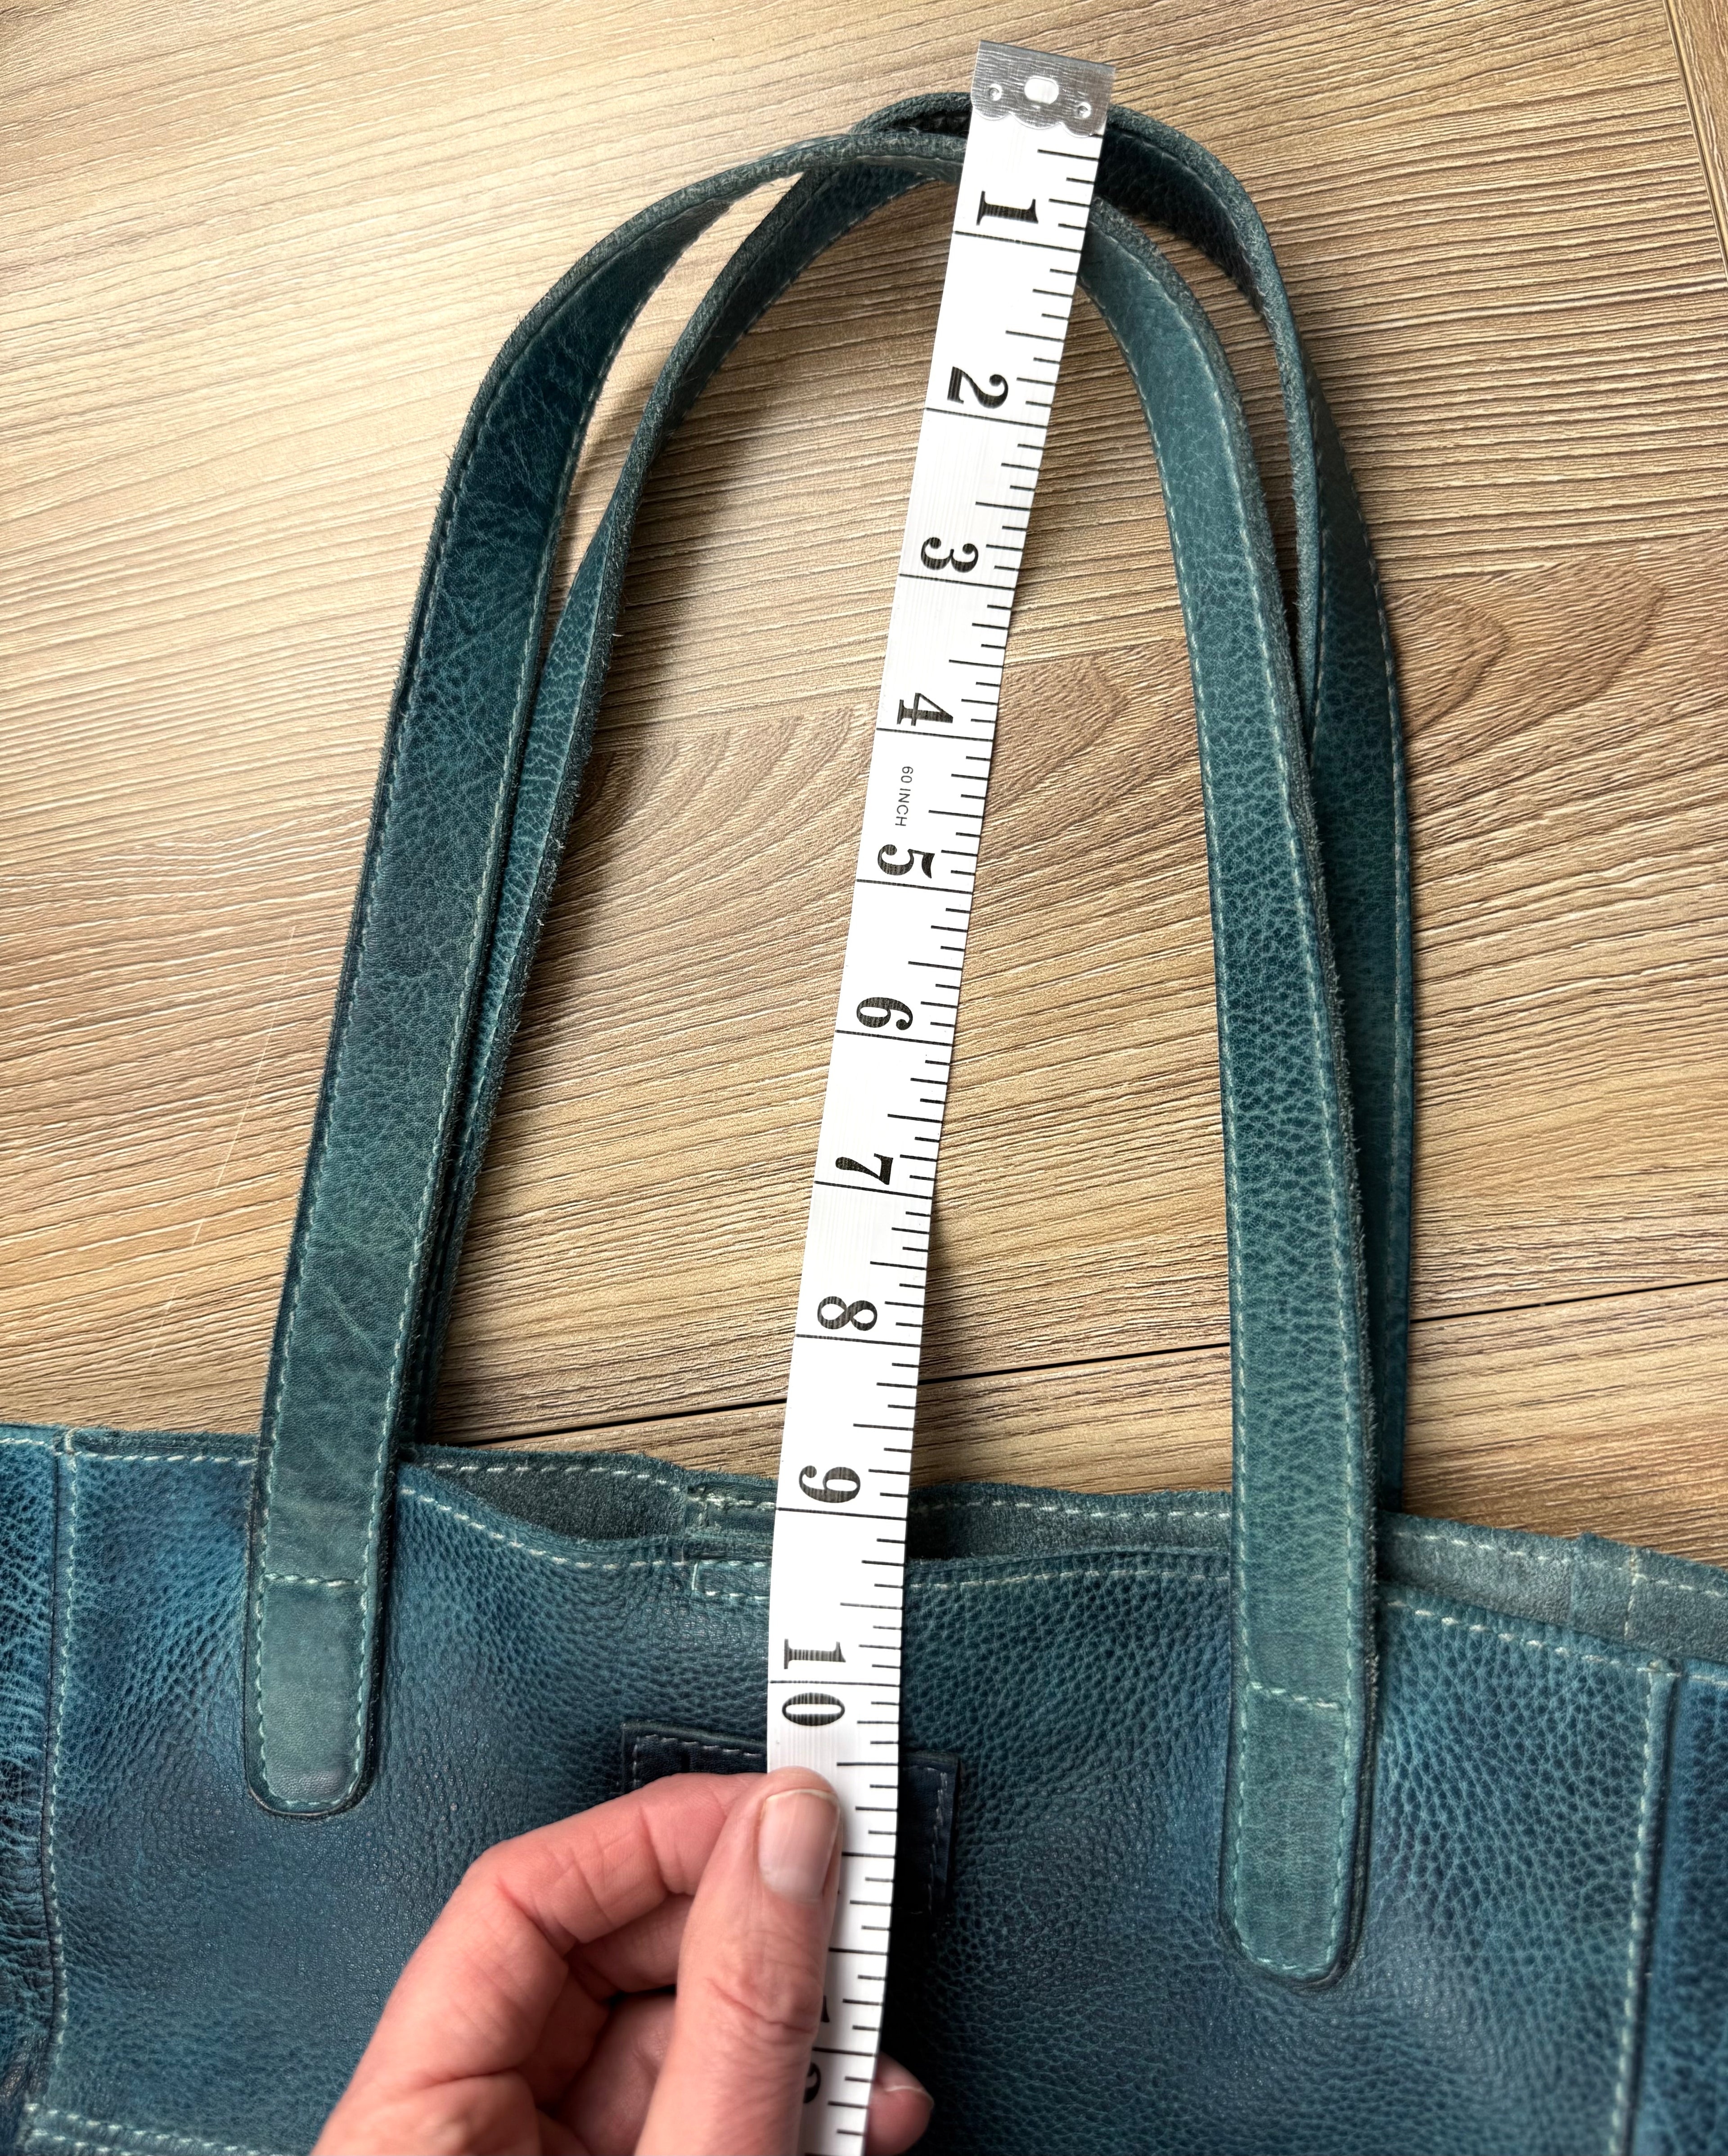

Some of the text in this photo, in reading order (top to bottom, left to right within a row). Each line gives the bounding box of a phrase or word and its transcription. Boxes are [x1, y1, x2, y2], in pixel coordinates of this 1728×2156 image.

[976, 190, 1039, 225] 1
[947, 366, 1009, 409] 2
[920, 536, 979, 573] 3
[896, 692, 954, 726] 4
[895, 766, 914, 827] 60 INCH
[877, 844, 936, 879] 5
[856, 996, 914, 1031] 6
[835, 1152, 894, 1185] 7
[817, 1296, 878, 1332] 8
[798, 1465, 861, 1503] 9
[781, 1638, 846, 1726] 10
